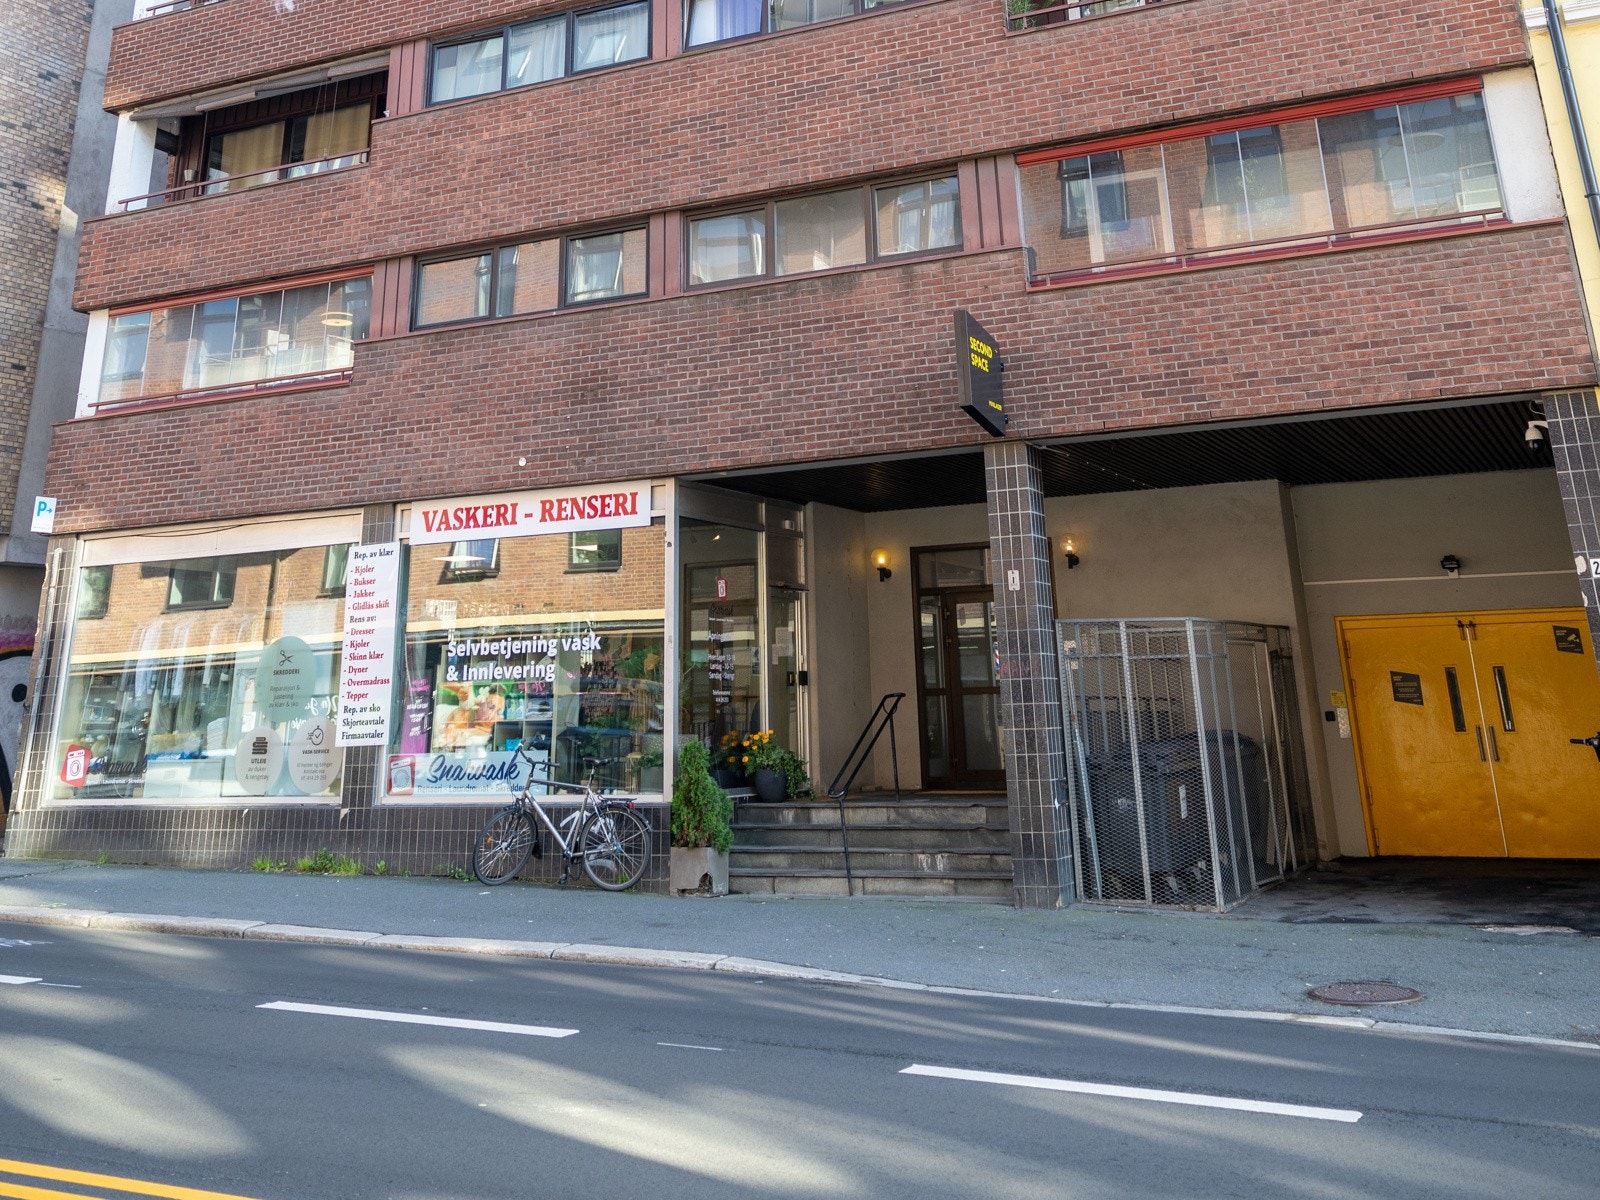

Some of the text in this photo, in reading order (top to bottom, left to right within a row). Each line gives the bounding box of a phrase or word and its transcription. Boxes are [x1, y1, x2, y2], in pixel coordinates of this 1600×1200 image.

[969, 336, 993, 359] SECOND
[971, 352, 989, 373] SPACE
[37, 500, 47, 517] P
[422, 502, 518, 533] VASKERI
[539, 491, 639, 523] RENSERI
[354, 551, 368, 561] Rep.
[379, 548, 394, 557] klær
[354, 564, 375, 576] Kjoler
[354, 578, 376, 587] Bukser
[353, 589, 375, 599] Jakker
[375, 599, 390, 609] skift
[349, 615, 365, 624] Rens
[350, 628, 375, 636] Dresser
[349, 640, 370, 651] Kjoler
[447, 632, 601, 660] Selvbetjening vask
[349, 652, 367, 661] Skinn
[368, 651, 384, 660] klær
[273, 668, 300, 676] SKREDDERI
[348, 665, 369, 676] Dyner
[446, 660, 556, 682] & Innlevering
[347, 676, 390, 687] Overmadrass
[346, 691, 369, 702] Tepper
[343, 705, 358, 716] Rep.
[369, 703, 381, 713] sko
[342, 716, 385, 729] Skjorteavtale
[341, 729, 384, 740] Firmaavtaler
